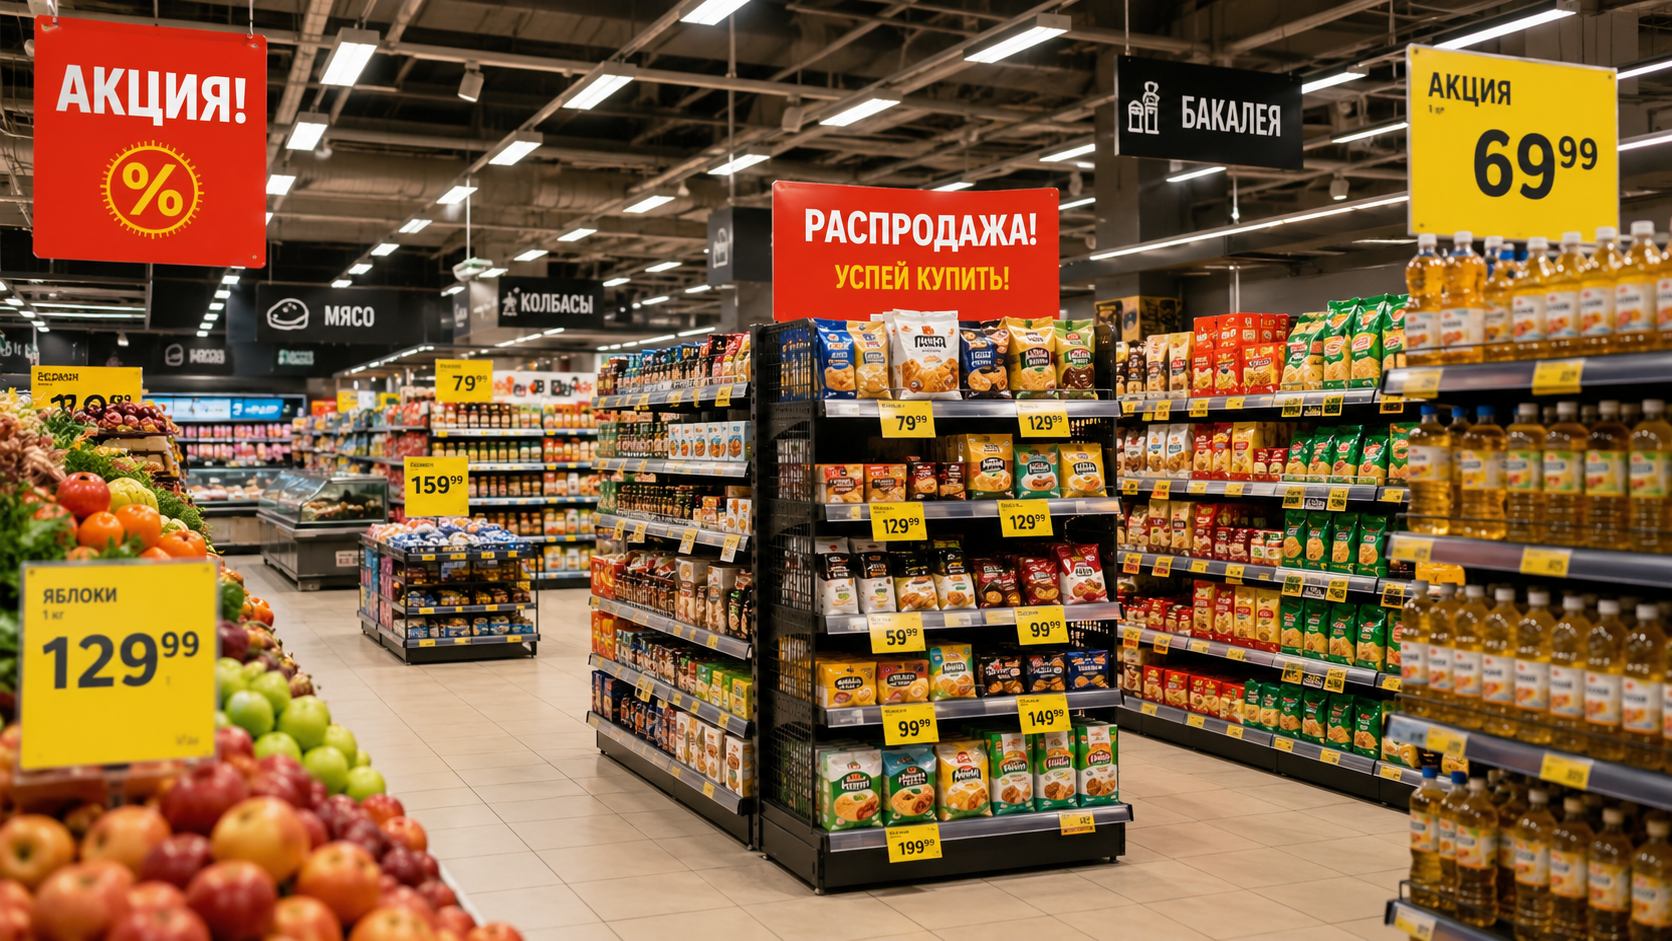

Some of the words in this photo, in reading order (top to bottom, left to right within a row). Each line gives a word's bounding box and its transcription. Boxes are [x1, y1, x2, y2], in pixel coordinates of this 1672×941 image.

[56, 64, 247, 127] АКЦИЯ!
[1428, 71, 1511, 107] АКЦИЯ
[1181, 94, 1281, 137] БАКАЛЕЯ
[804, 208, 1037, 252] РАСПРОДАЖА!
[834, 261, 910, 290] УСПЕЙ
[917, 266, 1010, 291] КУПИТЬ!
[324, 305, 375, 328] МЯСО
[520, 292, 594, 315] КОЛБАСЫ
[43, 587, 117, 604] ЯБЛОКИ
[43, 610, 49, 620] 1
[51, 610, 64, 620] кг
